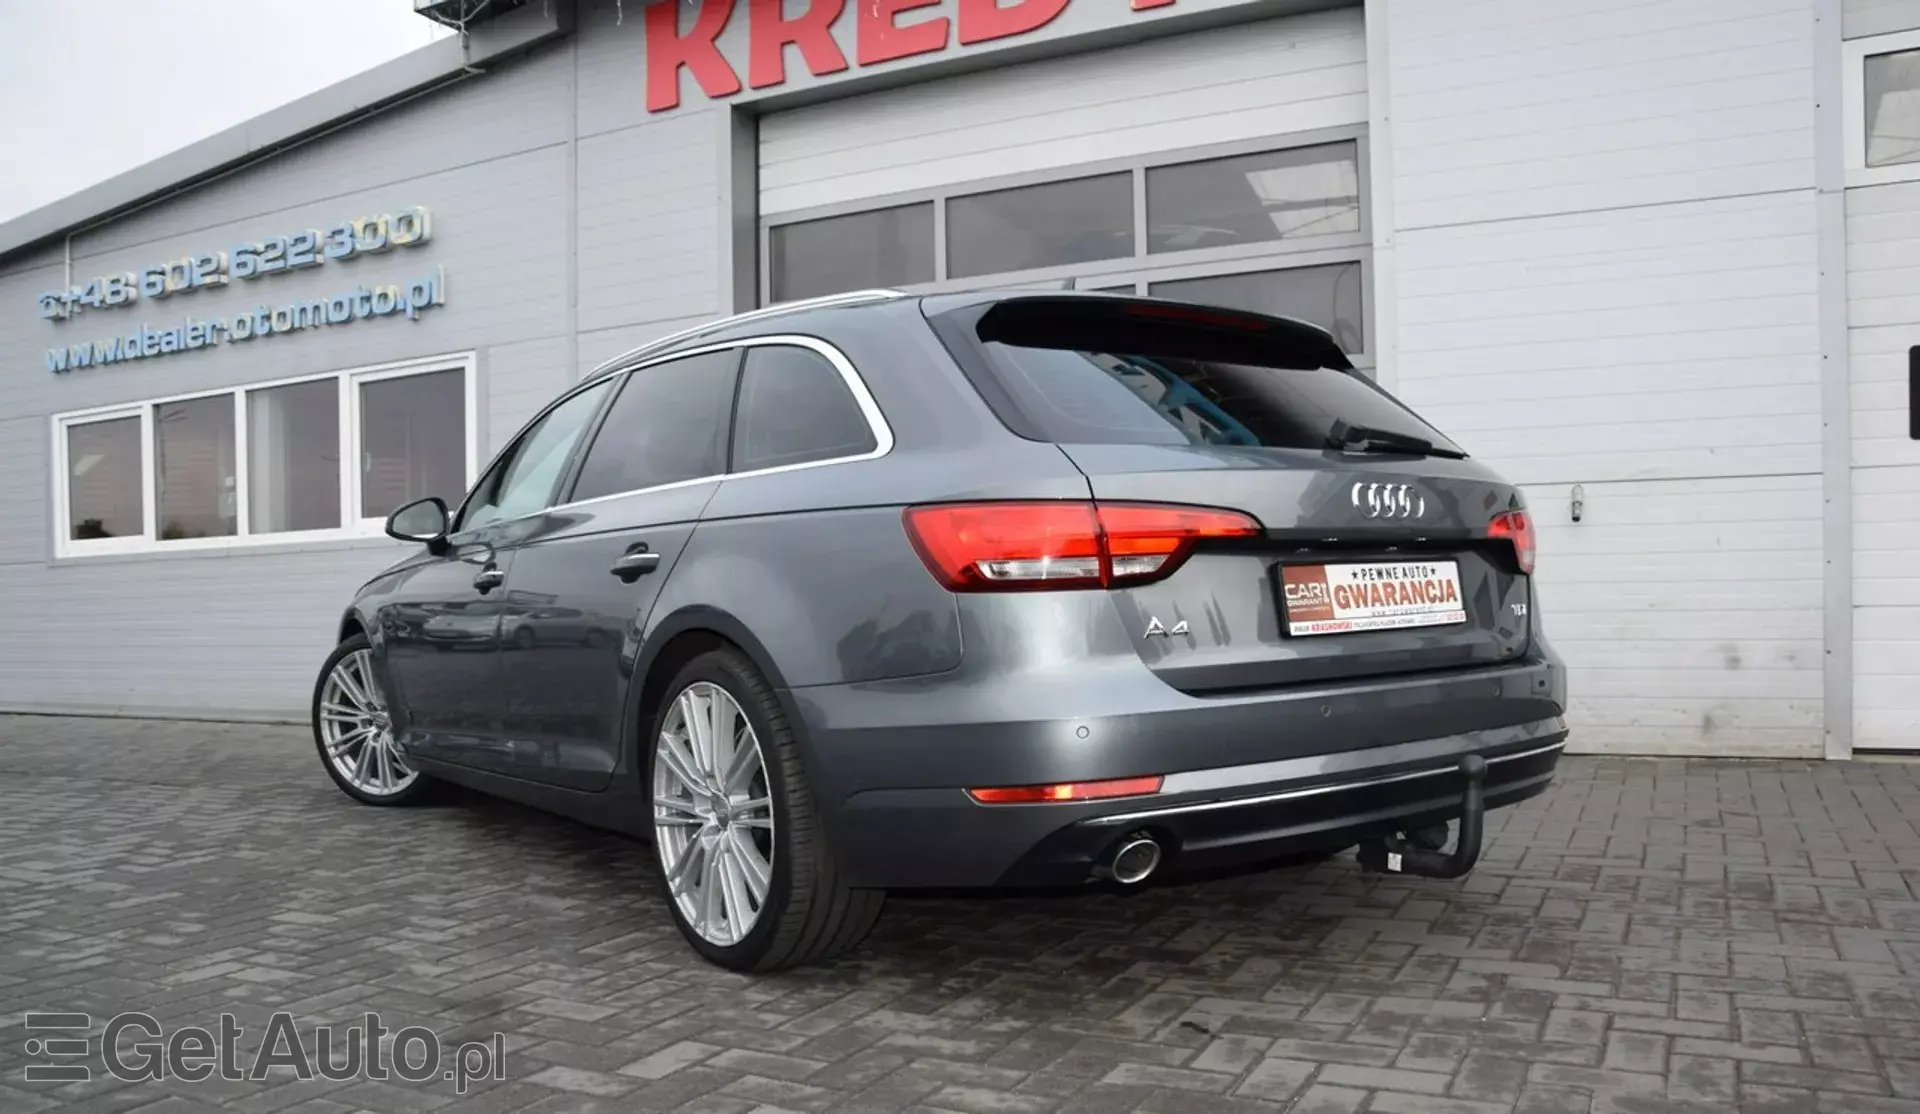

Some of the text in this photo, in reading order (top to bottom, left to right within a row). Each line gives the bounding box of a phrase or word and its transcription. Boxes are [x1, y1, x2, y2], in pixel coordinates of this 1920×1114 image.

[140, 250, 229, 299] 602
[229, 227, 324, 279] 622
[324, 205, 431, 260] 300
[1360, 565, 1428, 581] PEWNE AUTO
[1333, 579, 1458, 610] GWARANCJA
[1143, 616, 1189, 640] A4
